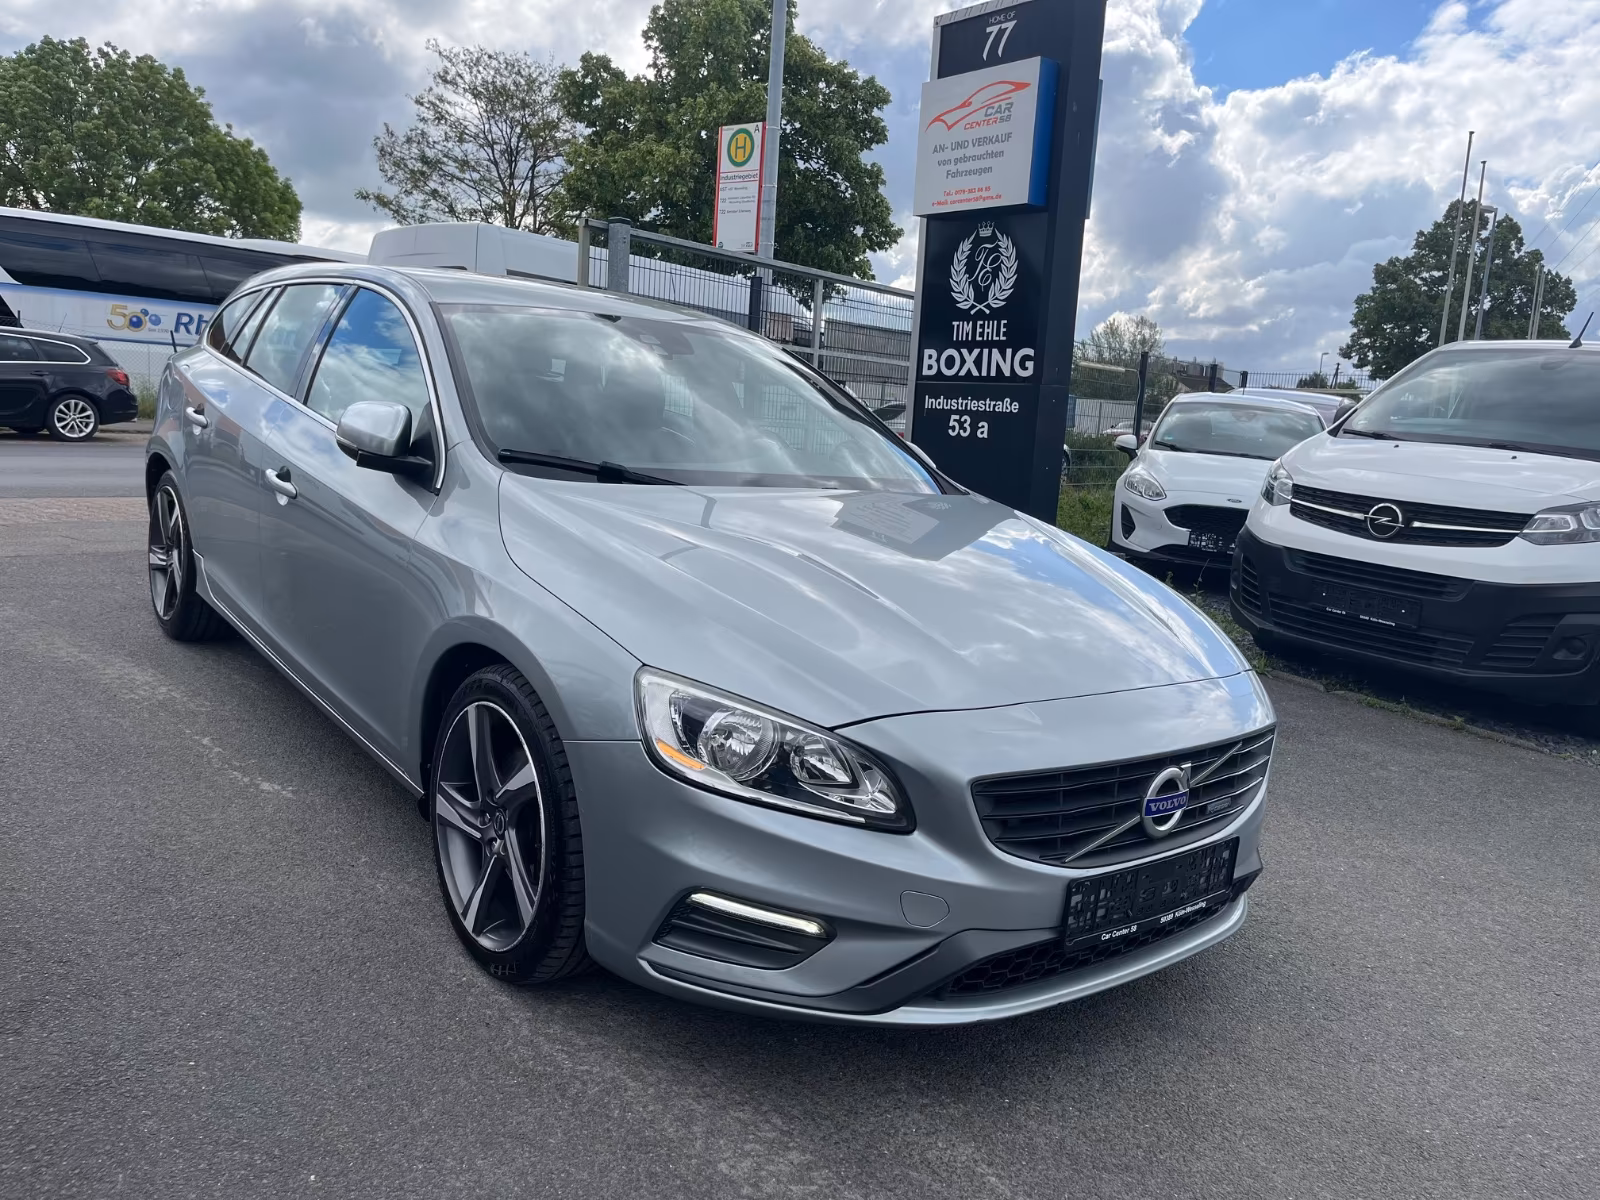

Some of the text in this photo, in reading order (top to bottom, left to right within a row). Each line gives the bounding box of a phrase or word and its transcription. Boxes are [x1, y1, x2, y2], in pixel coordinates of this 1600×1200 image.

[989, 14, 1005, 24] HOME
[982, 20, 1018, 61] 77
[984, 102, 1014, 118] CAR
[754, 124, 760, 133] A
[932, 132, 1013, 155] AN- UND VERKAUF
[937, 149, 1005, 167] von gebrauchten
[946, 166, 993, 179] Fahrzeugen
[952, 320, 1007, 341] TIM EHLE
[922, 348, 1035, 378] BOXING
[924, 395, 1019, 413] Industriestraße
[948, 415, 989, 439] 53 a
[1149, 796, 1187, 812] VOLVO
[1101, 932, 1112, 940] Car
[1112, 927, 1130, 938] Center
